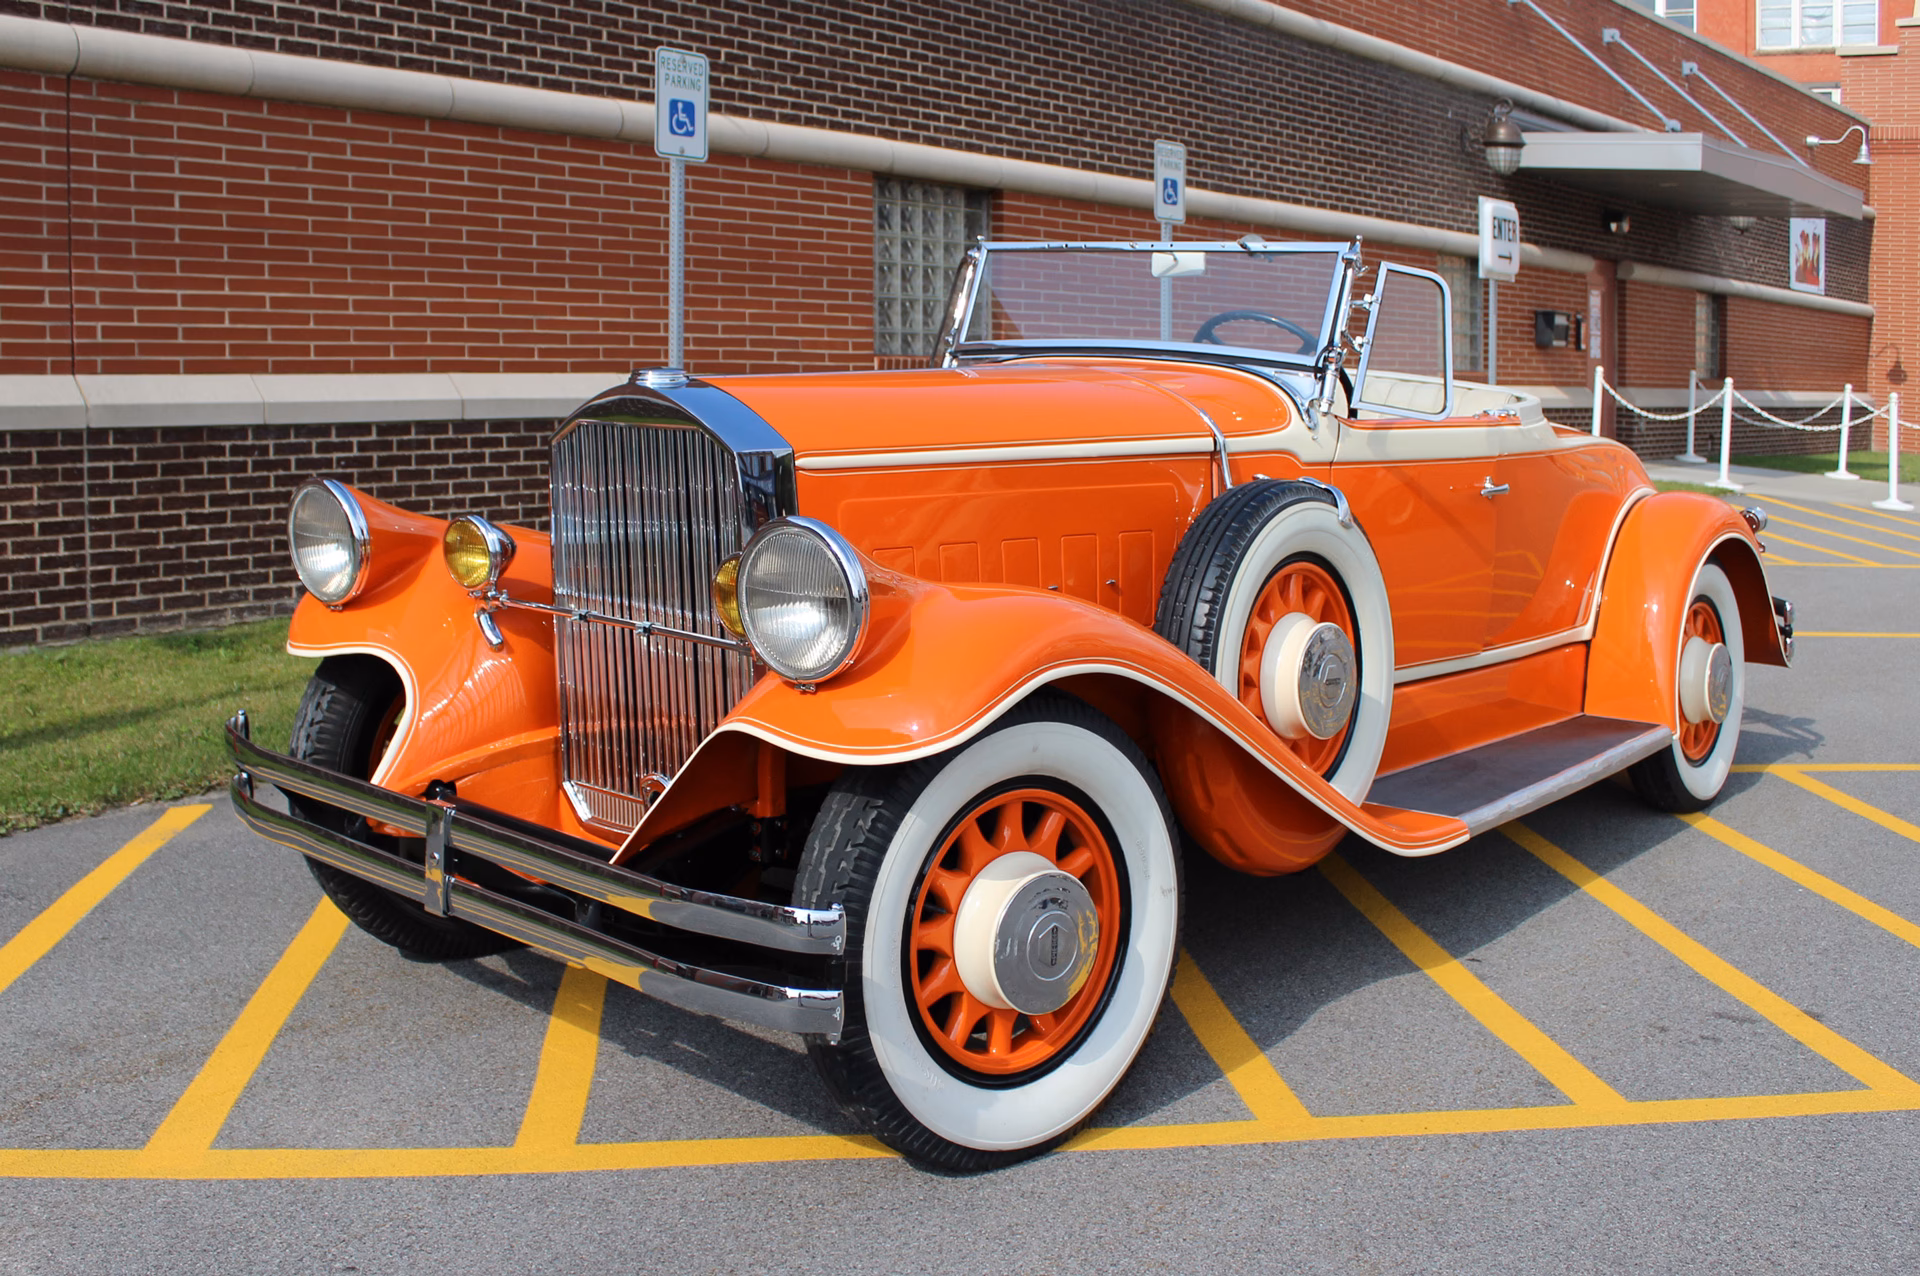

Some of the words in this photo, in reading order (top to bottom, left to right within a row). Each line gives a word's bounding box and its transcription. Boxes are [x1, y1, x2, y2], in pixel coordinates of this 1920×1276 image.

[660, 56, 704, 77] RESERVED
[664, 73, 702, 92] PARKING
[1493, 216, 1518, 243] ENTER
